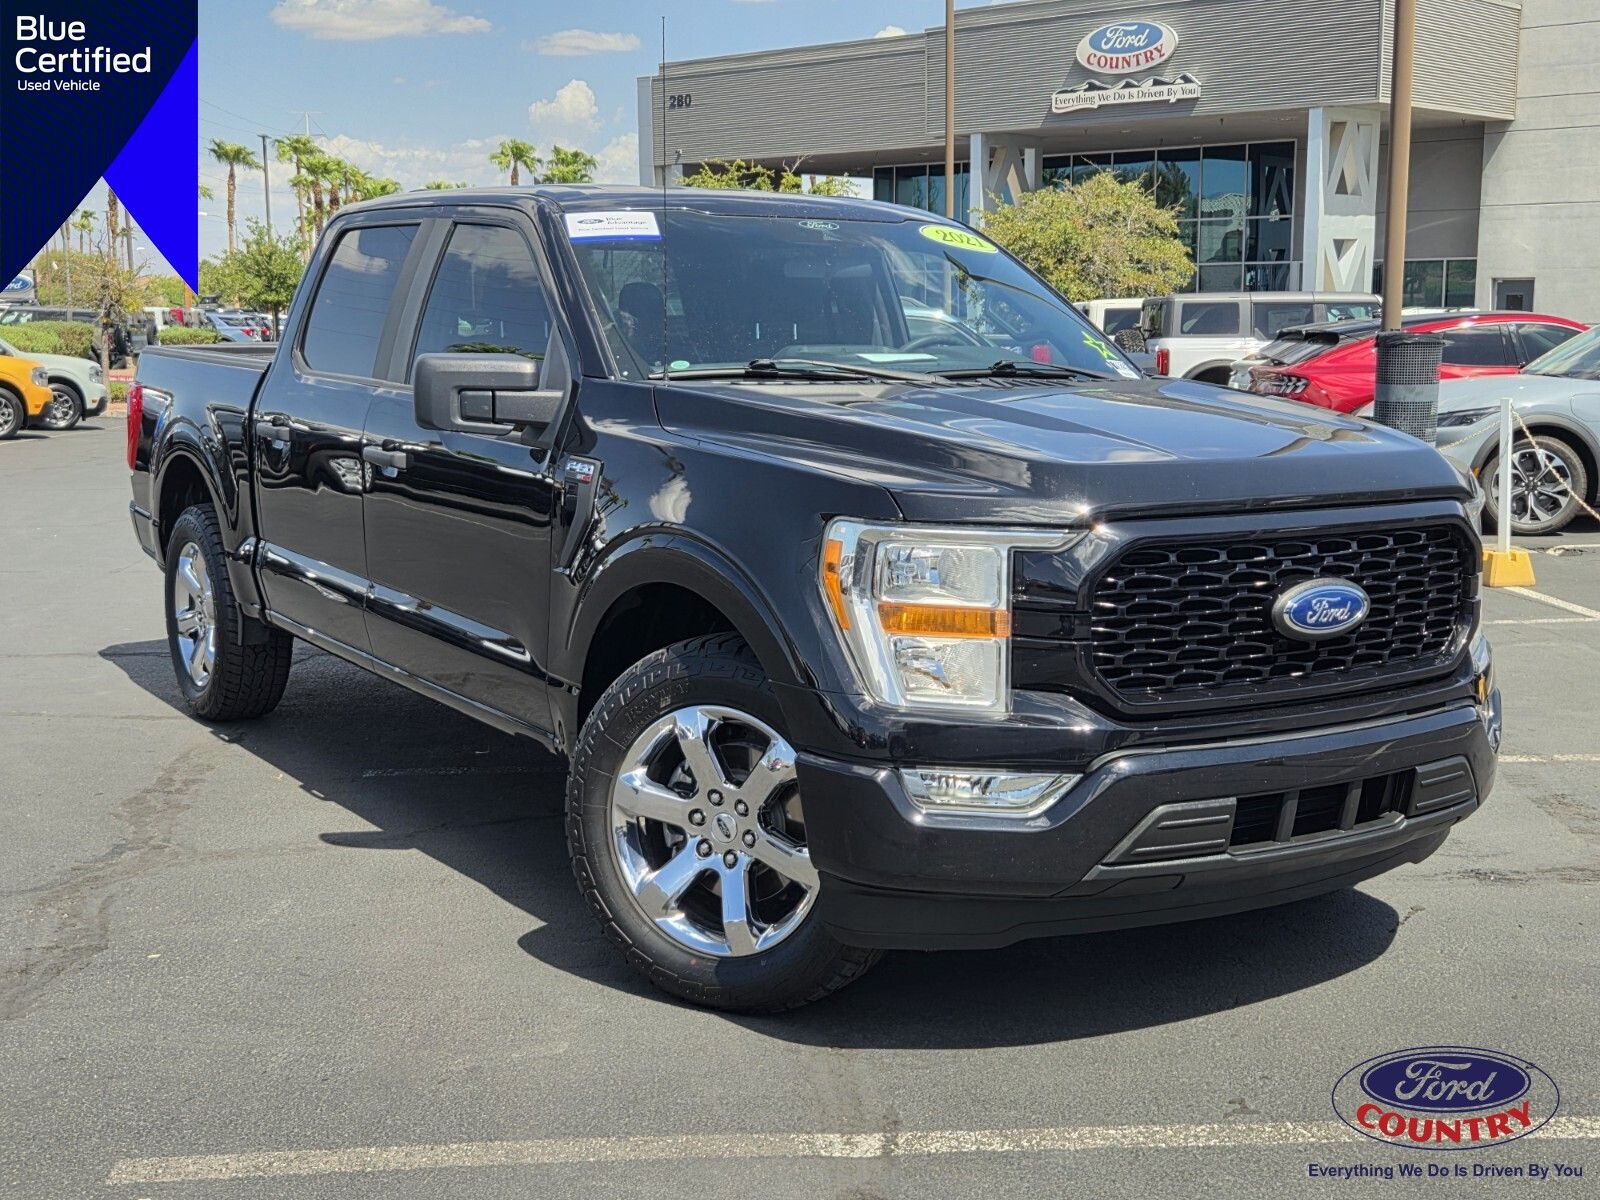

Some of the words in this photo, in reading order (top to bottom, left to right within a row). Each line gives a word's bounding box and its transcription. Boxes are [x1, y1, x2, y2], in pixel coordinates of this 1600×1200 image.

[1101, 25, 1150, 49] Ford
[1086, 43, 1166, 70] COUNTRY
[668, 94, 692, 110] 280
[1054, 94, 1096, 106] Everything
[1098, 92, 1111, 102] We
[1113, 91, 1126, 101] Do
[1128, 91, 1135, 99] Is
[1137, 89, 1165, 98] Driven
[1167, 87, 1178, 98] By
[1180, 86, 1196, 96] You
[935, 229, 987, 249] 2021
[1306, 597, 1351, 624] Ford
